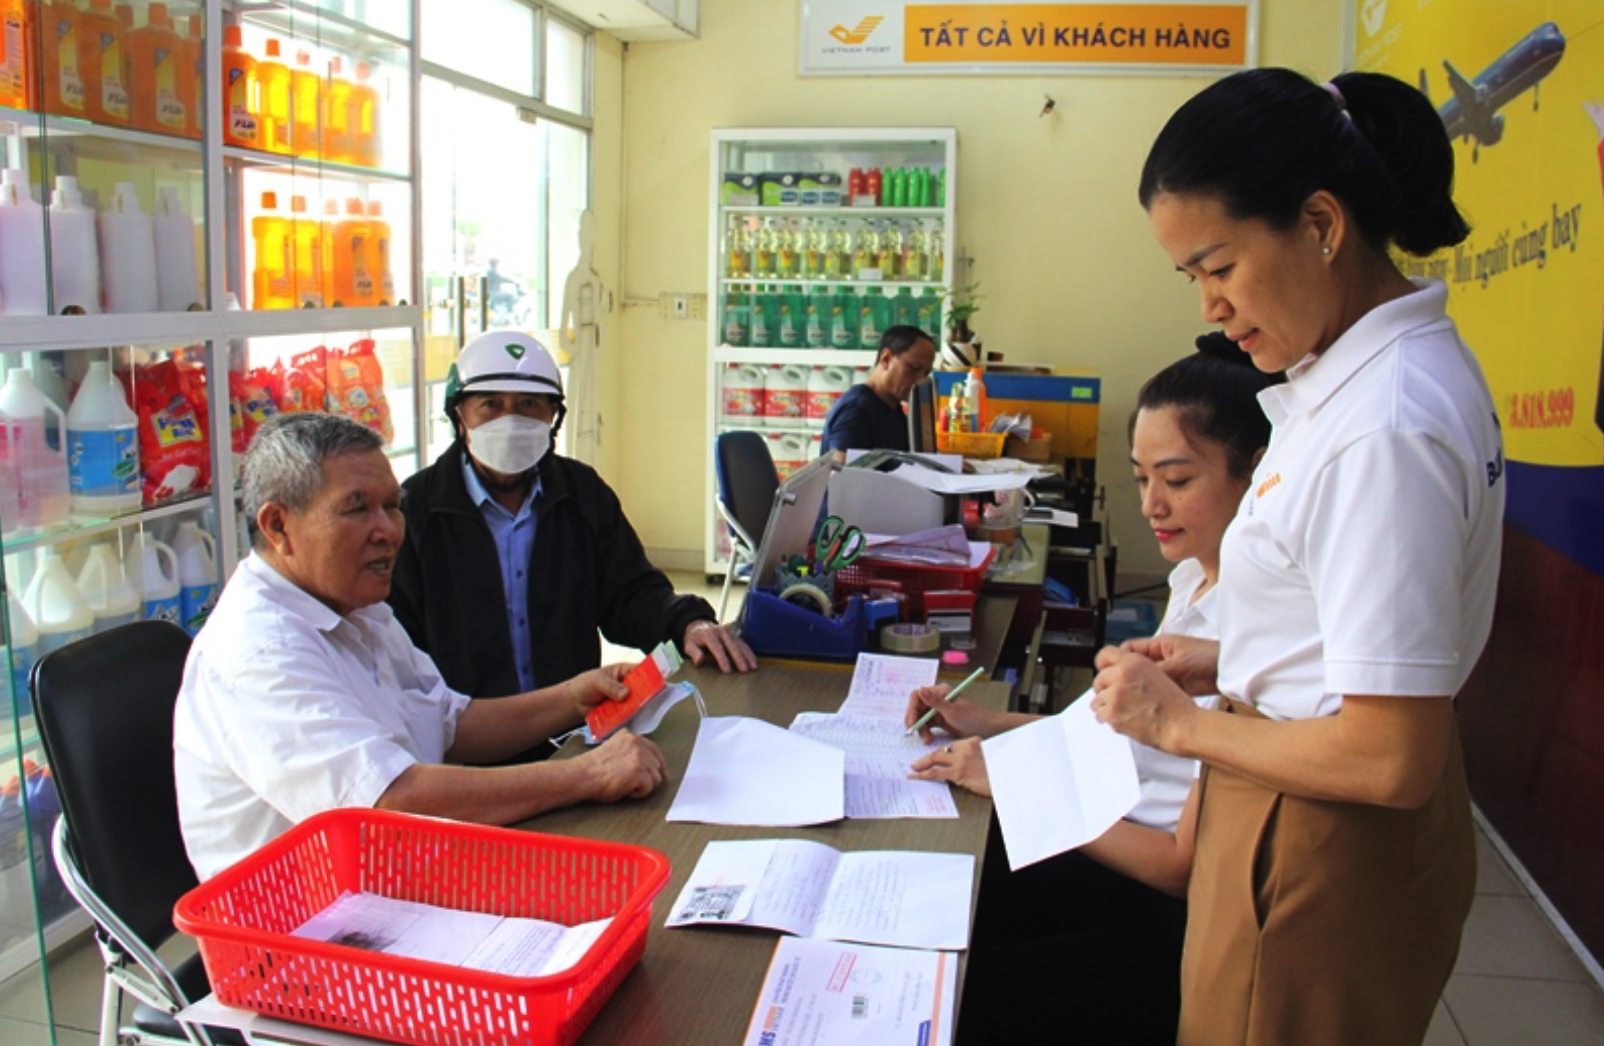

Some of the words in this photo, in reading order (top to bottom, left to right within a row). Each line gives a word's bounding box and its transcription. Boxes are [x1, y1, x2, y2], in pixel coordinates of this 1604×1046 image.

[920, 19, 969, 47] TẤT
[977, 19, 1012, 47] CẢ
[1021, 21, 1045, 47] VÌ
[1054, 21, 1146, 48] KHÁCH
[1155, 22, 1231, 49] HÀNG
[821, 45, 863, 54] VIETNAM
[866, 45, 891, 53] POST
[1512, 221, 1548, 269] cùng
[1552, 203, 1582, 253] bay
